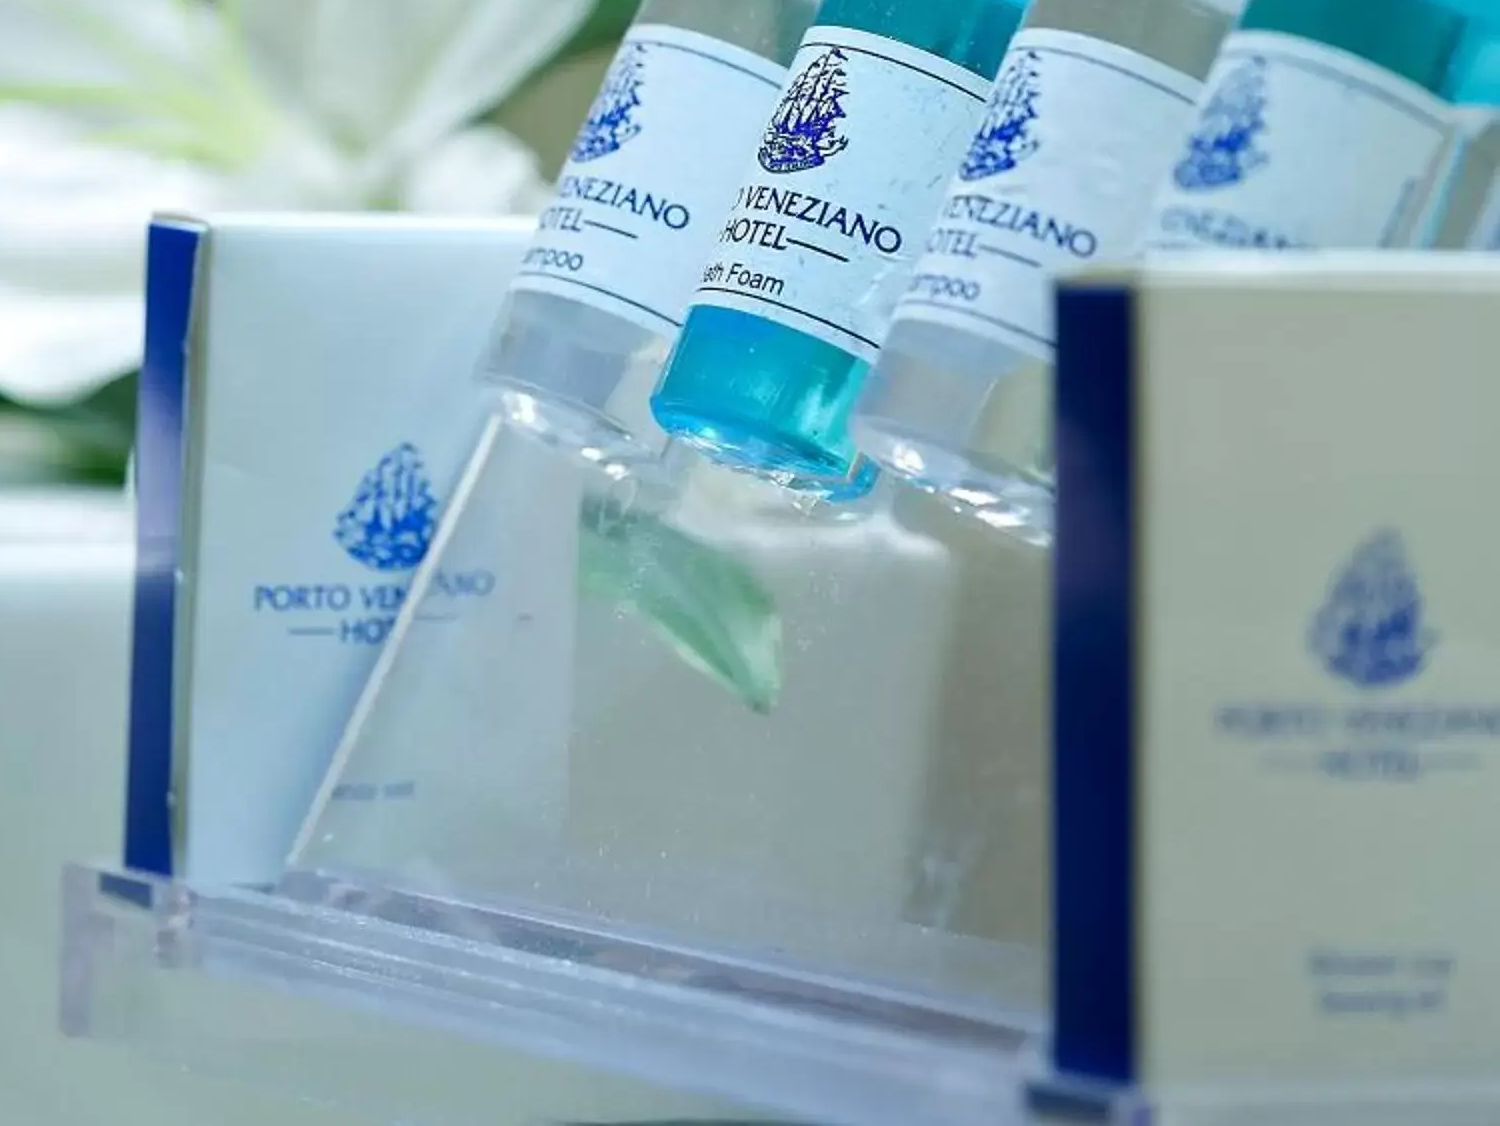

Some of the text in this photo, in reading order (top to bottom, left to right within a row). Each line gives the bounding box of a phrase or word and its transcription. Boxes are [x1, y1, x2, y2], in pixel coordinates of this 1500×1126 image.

[538, 206, 583, 232] OTEL
[560, 175, 691, 229] ENEZIANO
[744, 185, 902, 254] VENEZIANO
[719, 208, 788, 251] HOTEL
[926, 227, 979, 259] OTEL
[943, 194, 1097, 259] ENEZIANO
[725, 263, 785, 296] Foam
[253, 584, 352, 613] PORTO
